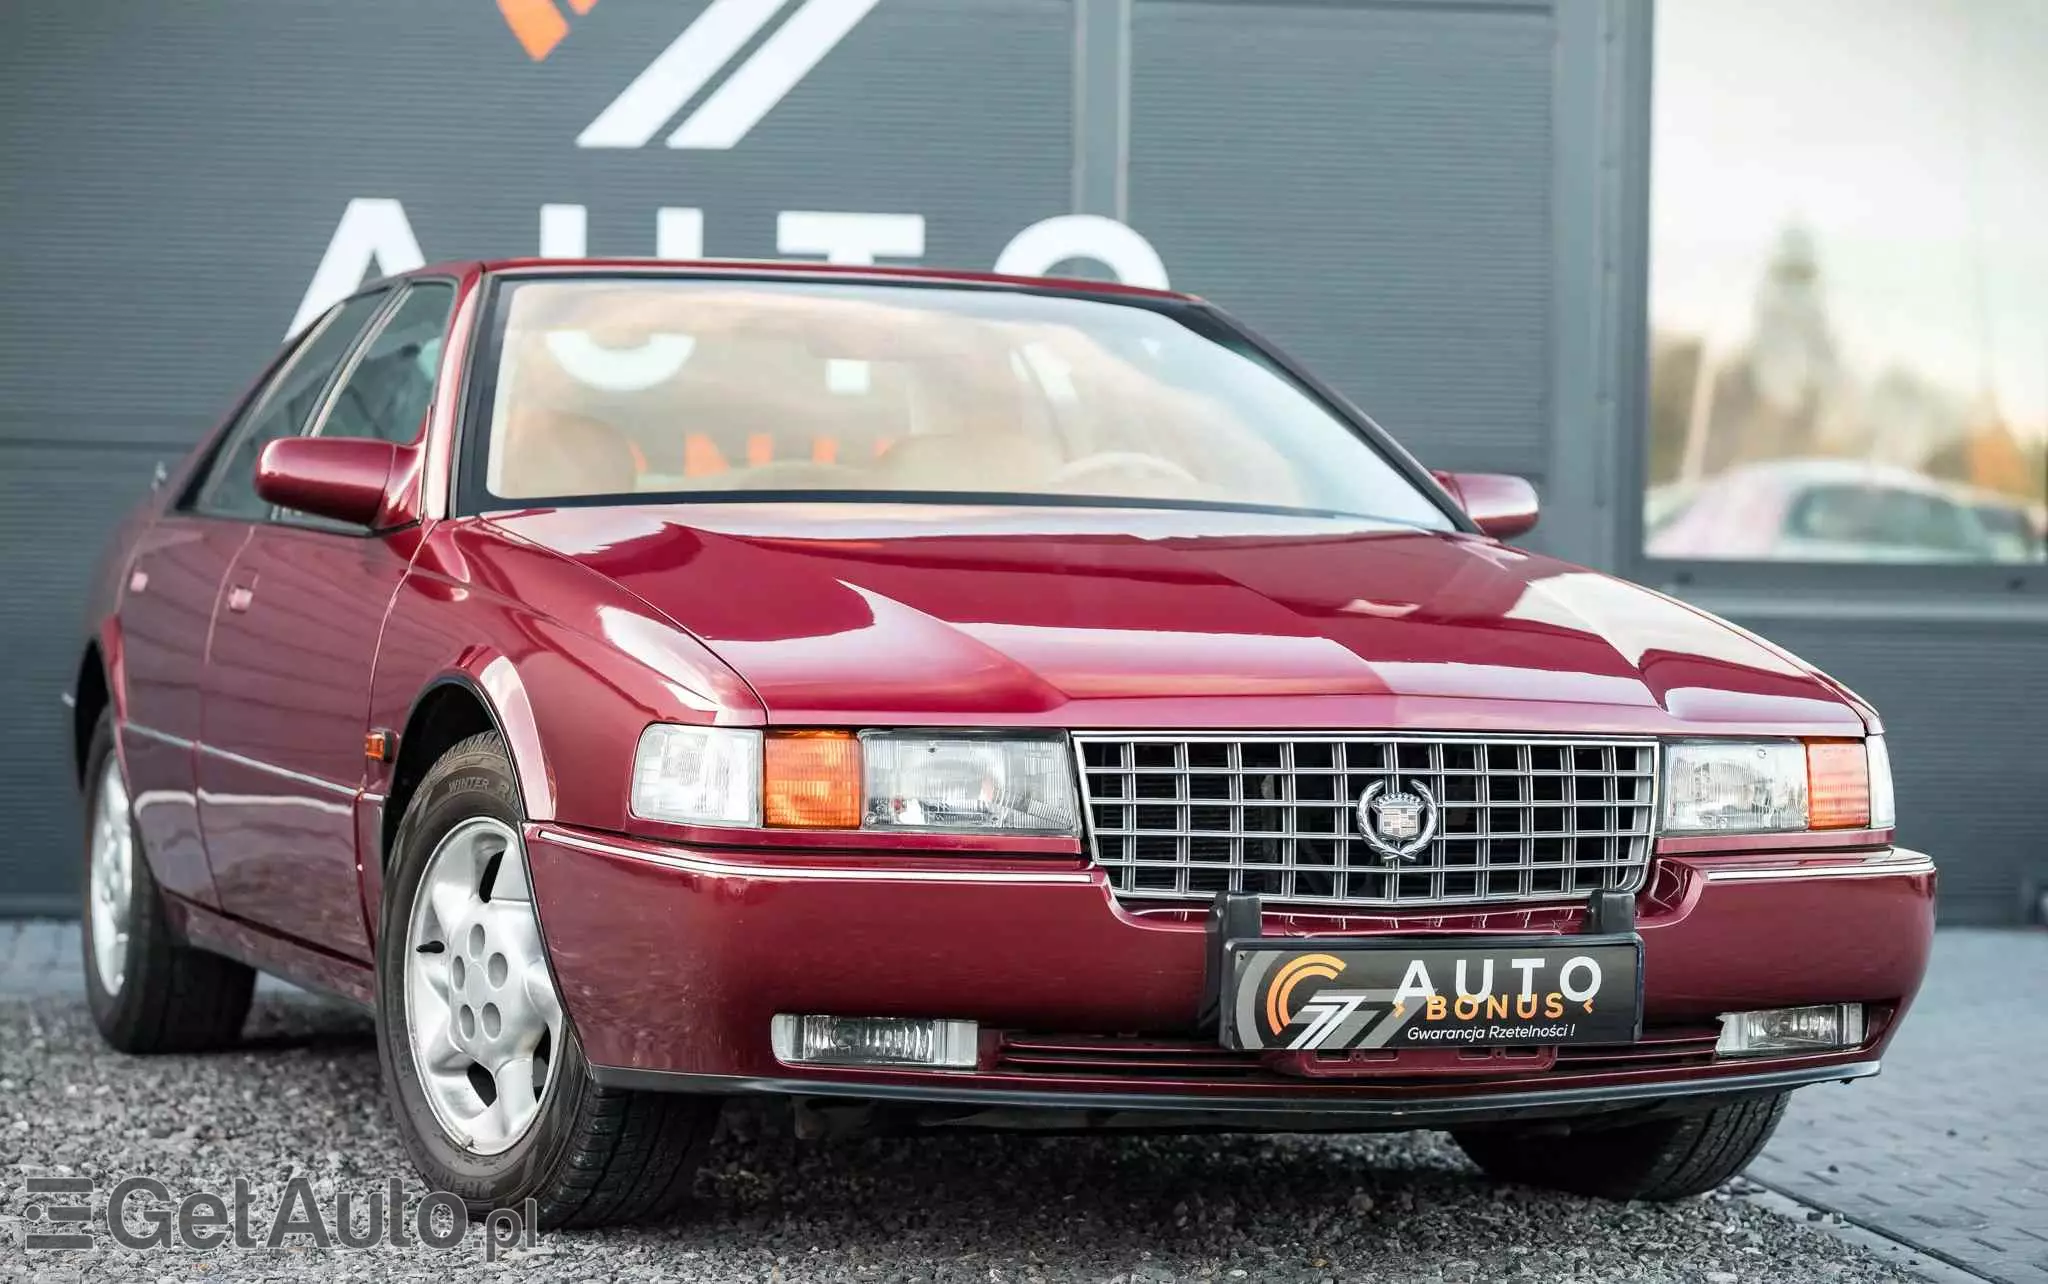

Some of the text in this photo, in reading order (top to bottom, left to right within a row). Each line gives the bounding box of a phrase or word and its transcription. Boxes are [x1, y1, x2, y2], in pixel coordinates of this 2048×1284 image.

[1393, 956, 1602, 1004] AUTO
[1426, 993, 1564, 1021] BONUS
[1407, 1025, 1486, 1042] Gwarancja
[1488, 1023, 1569, 1039] Rzetelności
